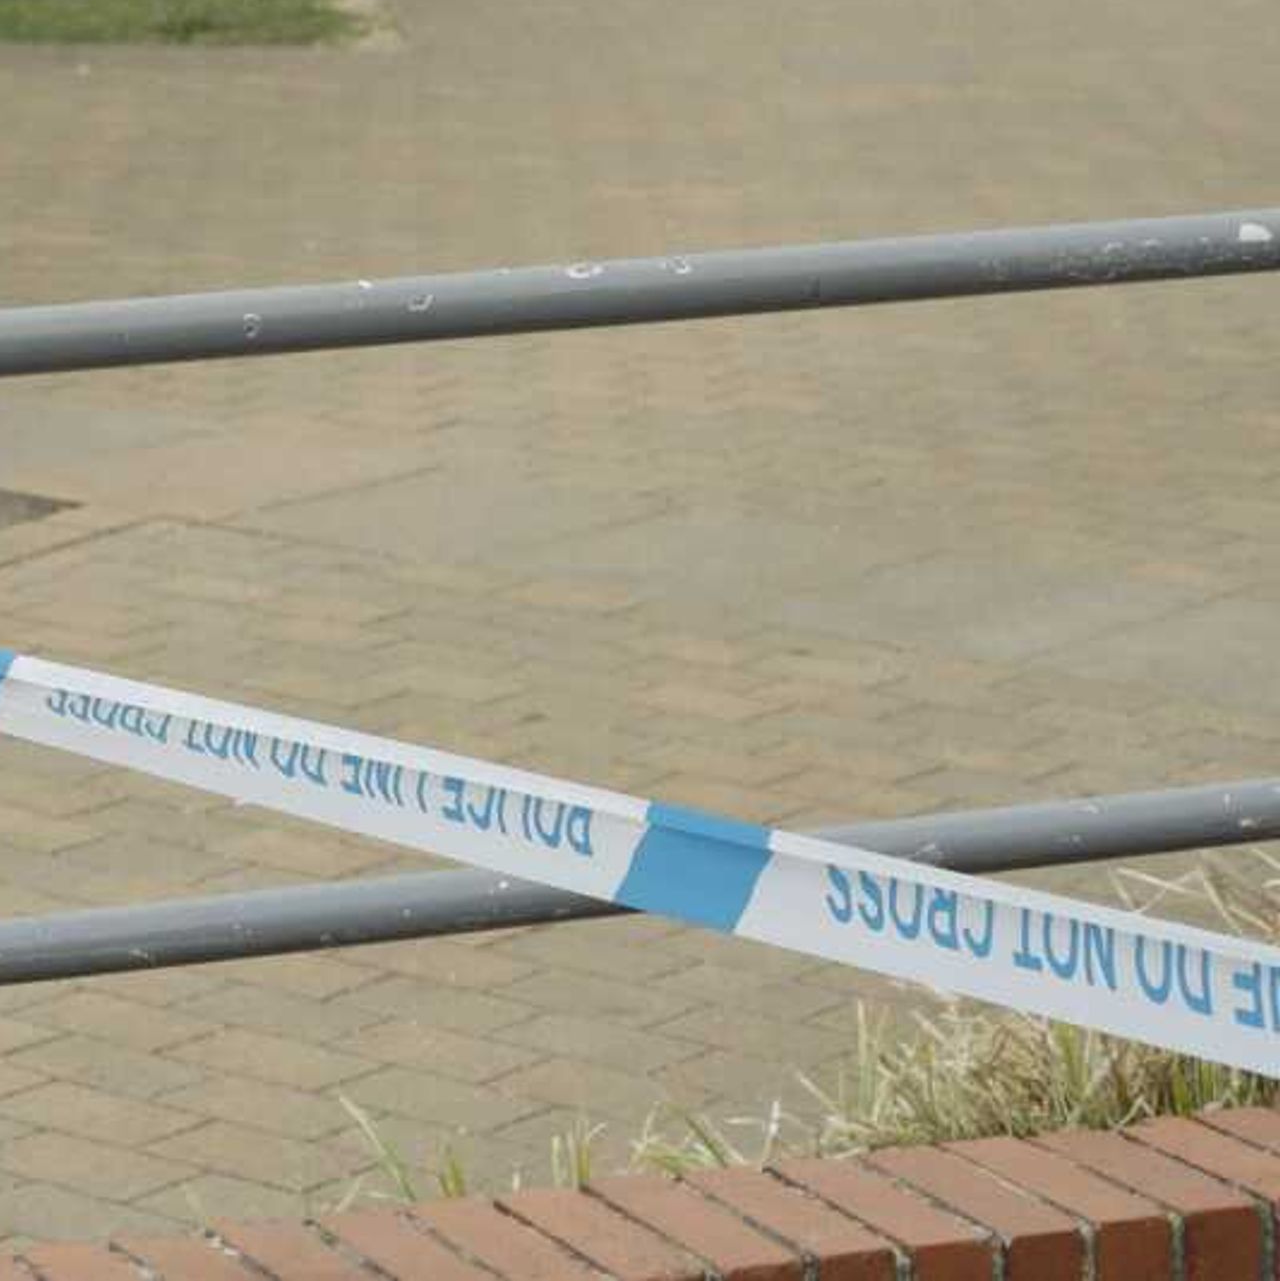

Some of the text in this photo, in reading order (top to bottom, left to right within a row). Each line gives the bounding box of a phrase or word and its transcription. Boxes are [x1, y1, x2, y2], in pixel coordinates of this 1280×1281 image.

[825, 863, 994, 960] CROSS
[1013, 907, 1118, 990] NOT
[1134, 933, 1214, 1017] DO
